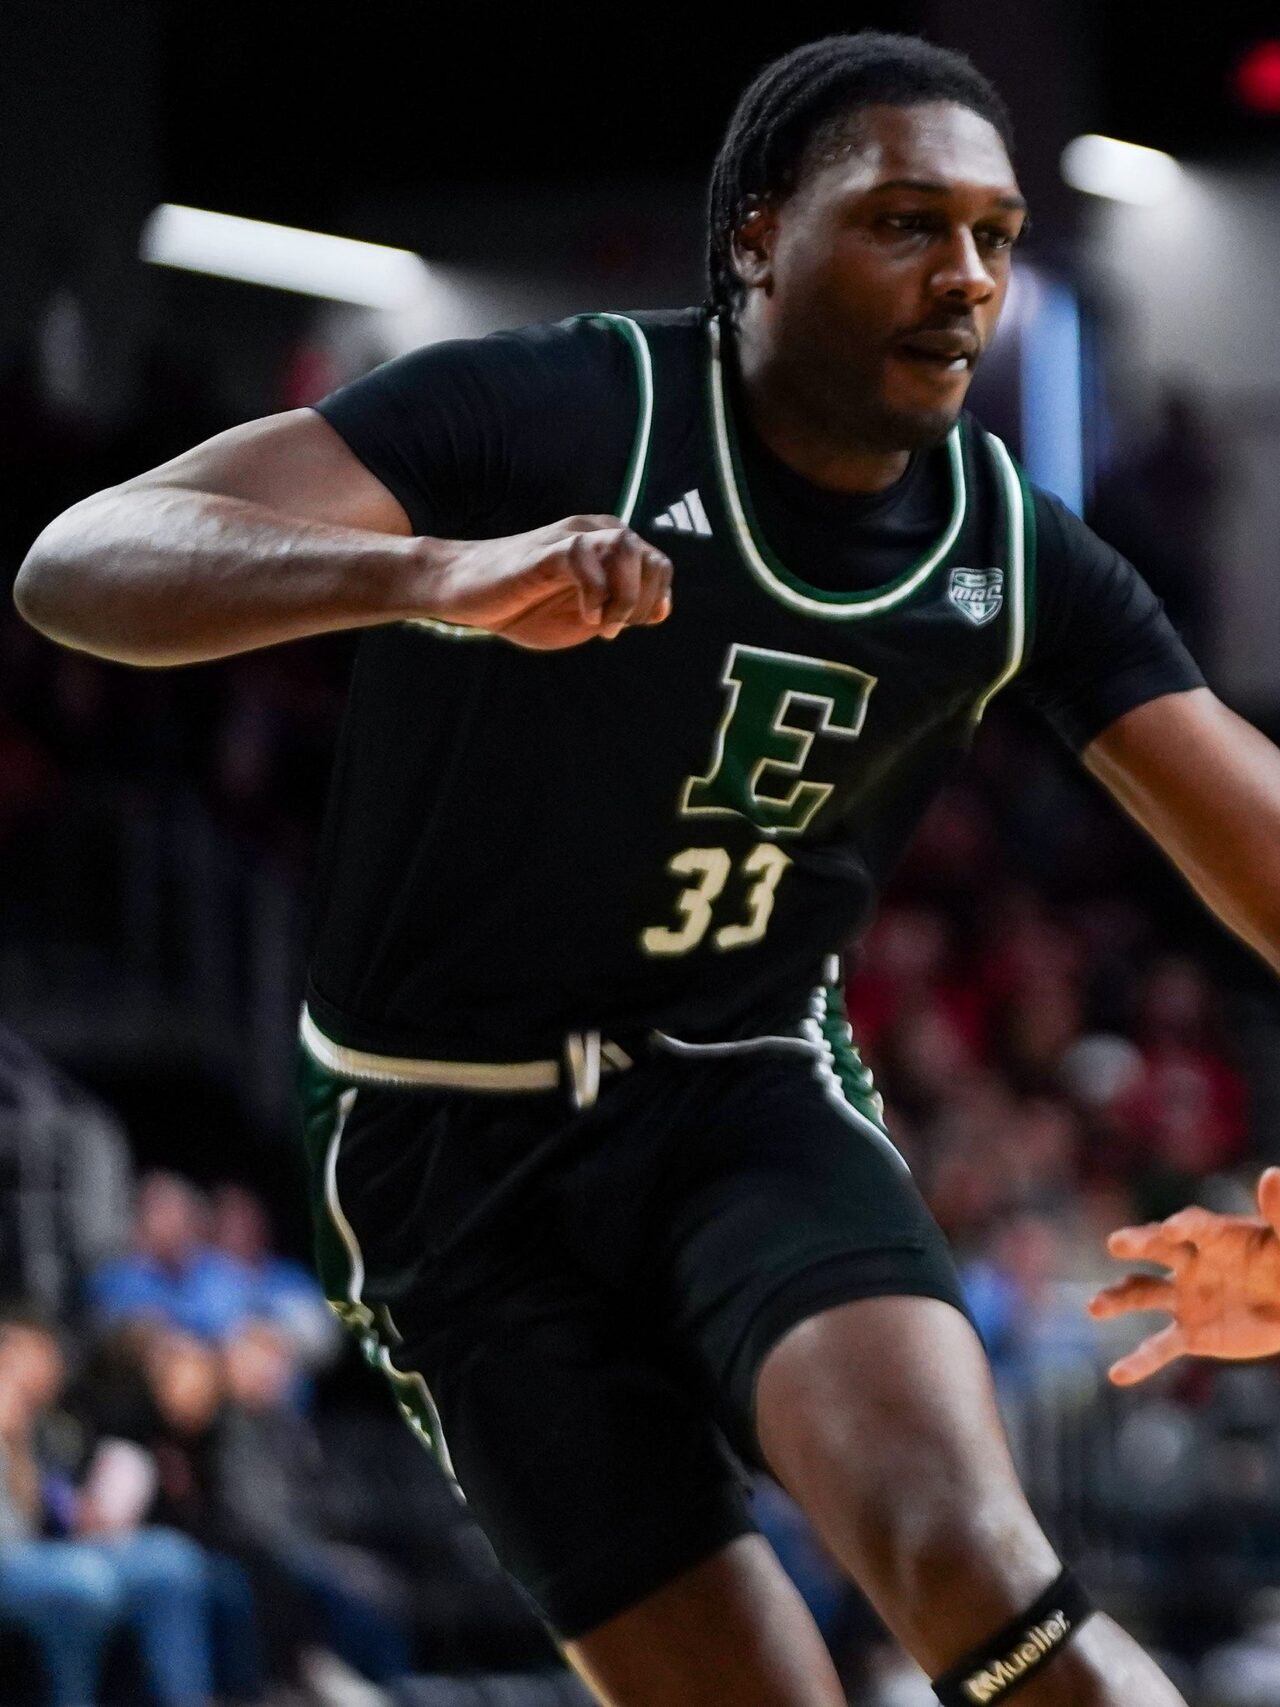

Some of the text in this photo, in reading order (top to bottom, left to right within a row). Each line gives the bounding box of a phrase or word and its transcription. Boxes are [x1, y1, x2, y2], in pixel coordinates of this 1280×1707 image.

[682, 643, 876, 836] E
[641, 842, 793, 954] 33
[974, 1609, 1067, 1694] Mueller
